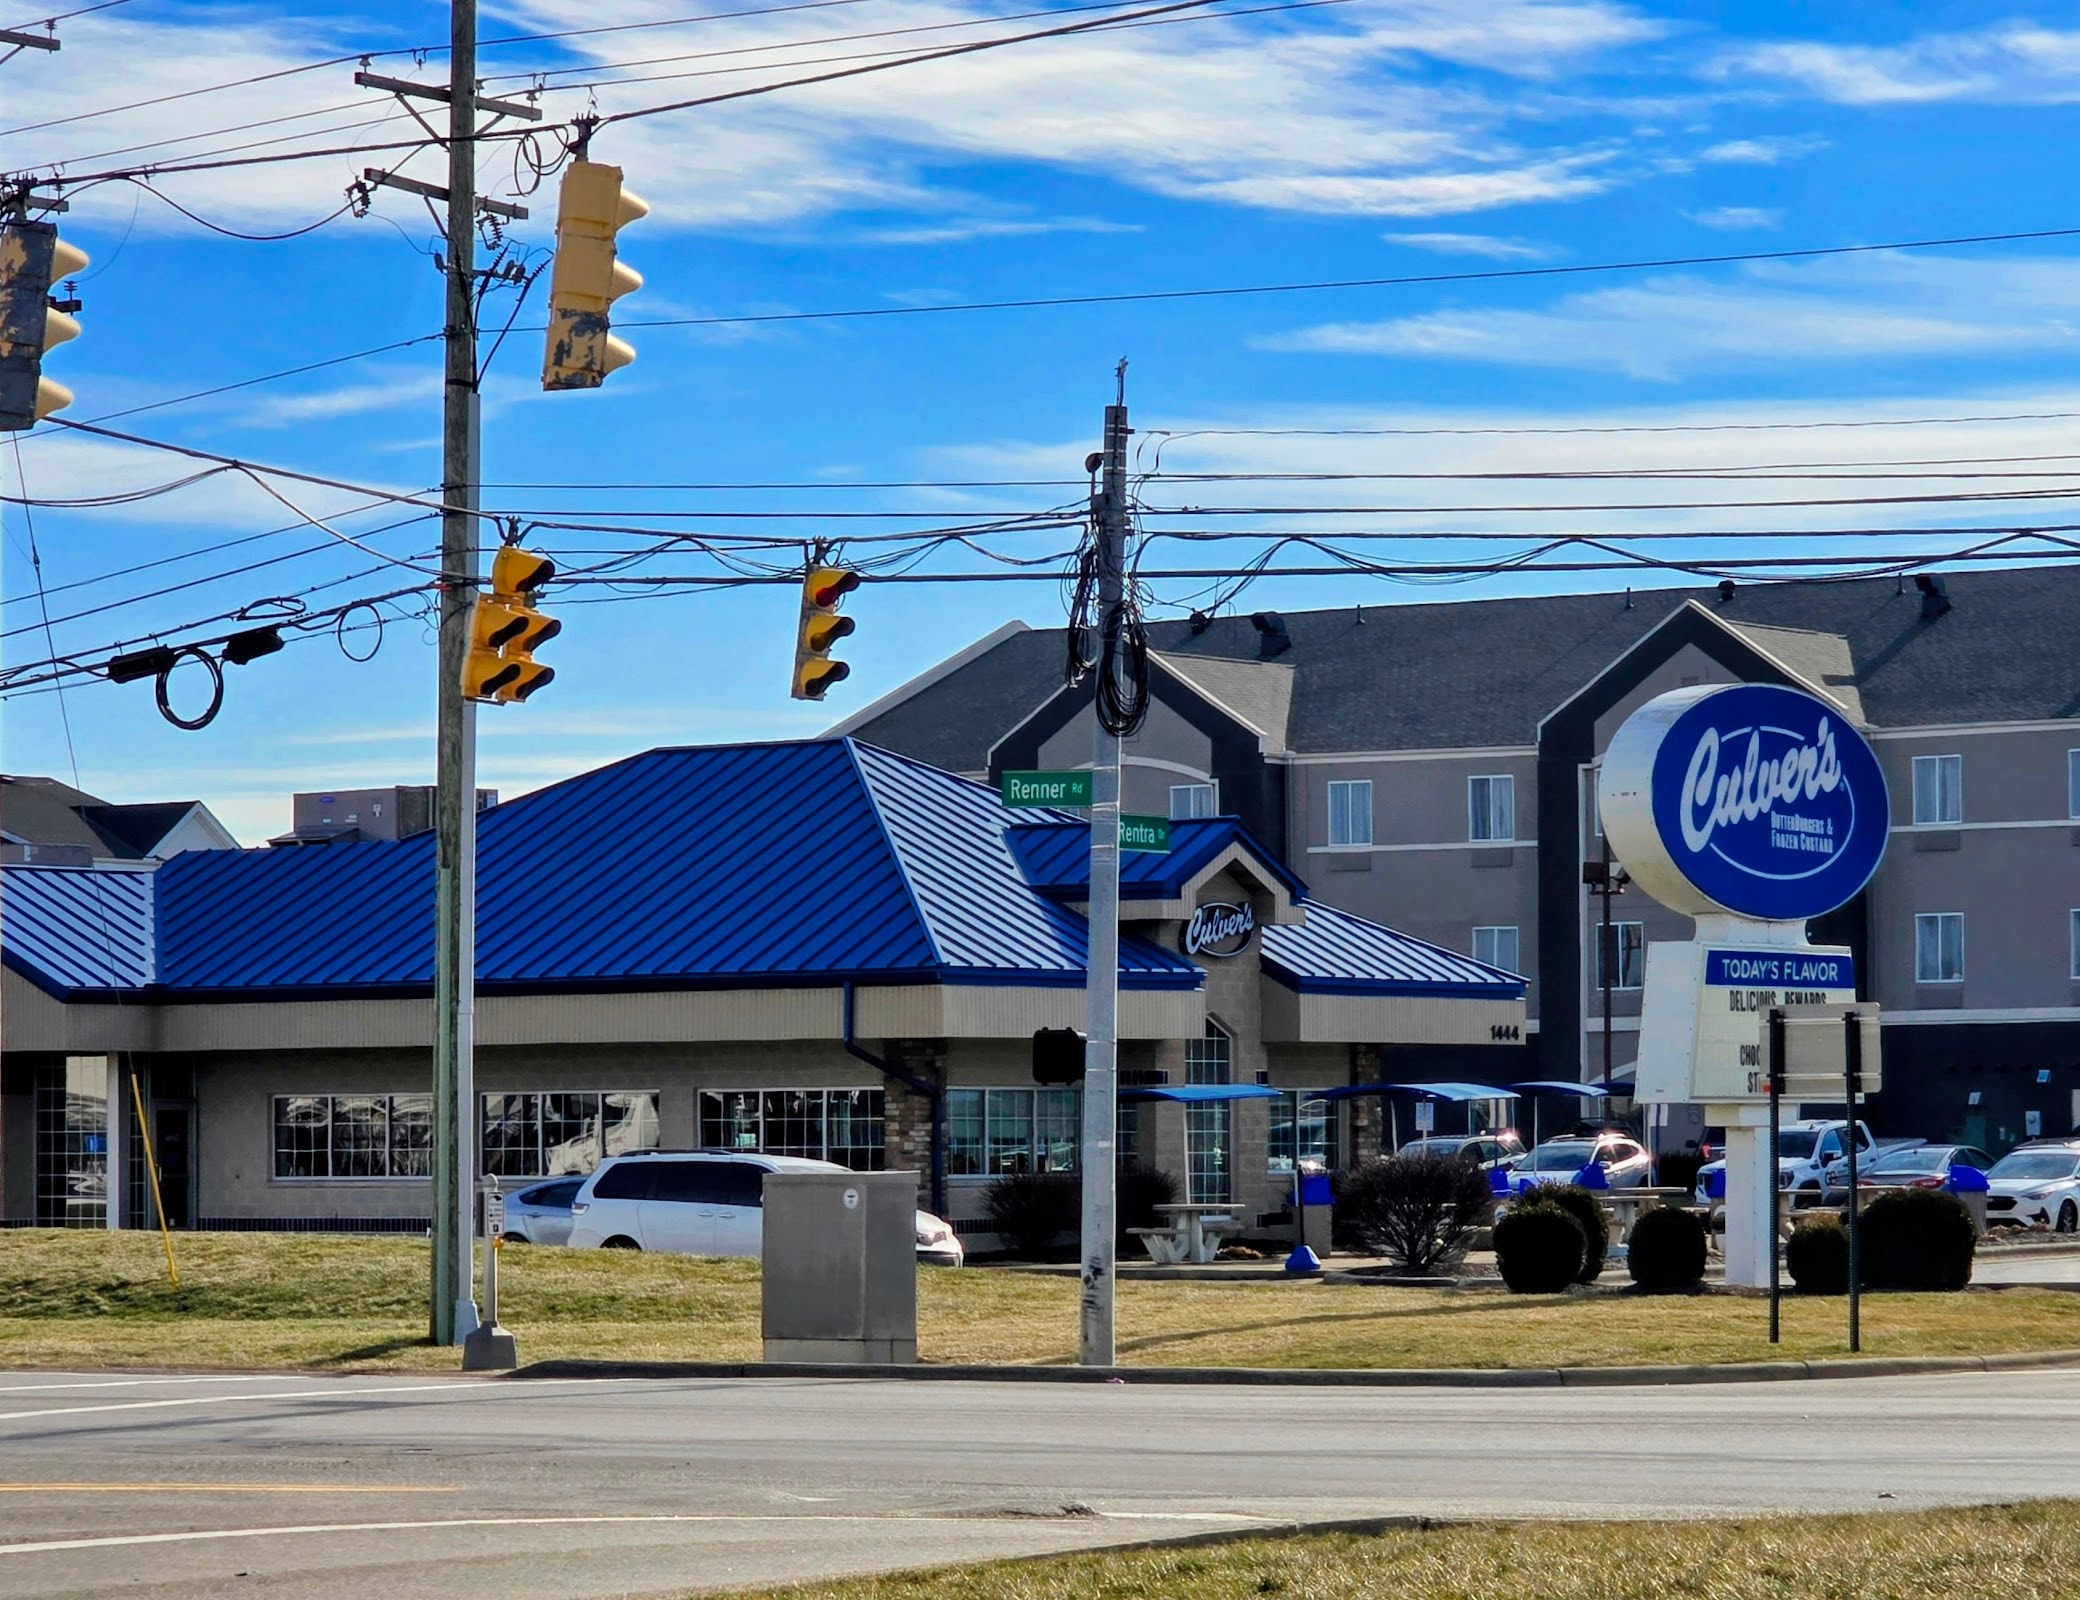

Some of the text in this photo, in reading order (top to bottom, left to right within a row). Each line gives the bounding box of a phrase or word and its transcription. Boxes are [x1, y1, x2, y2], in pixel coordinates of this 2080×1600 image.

[1010, 779, 1083, 800] Renner Rd
[1680, 716, 1841, 852] Culver's
[1119, 821, 1155, 844] Rentra
[1186, 902, 1254, 955] Culver's
[1722, 959, 1838, 982] TODAY'S FLAVOR
[1490, 1025, 1520, 1041] 1444
